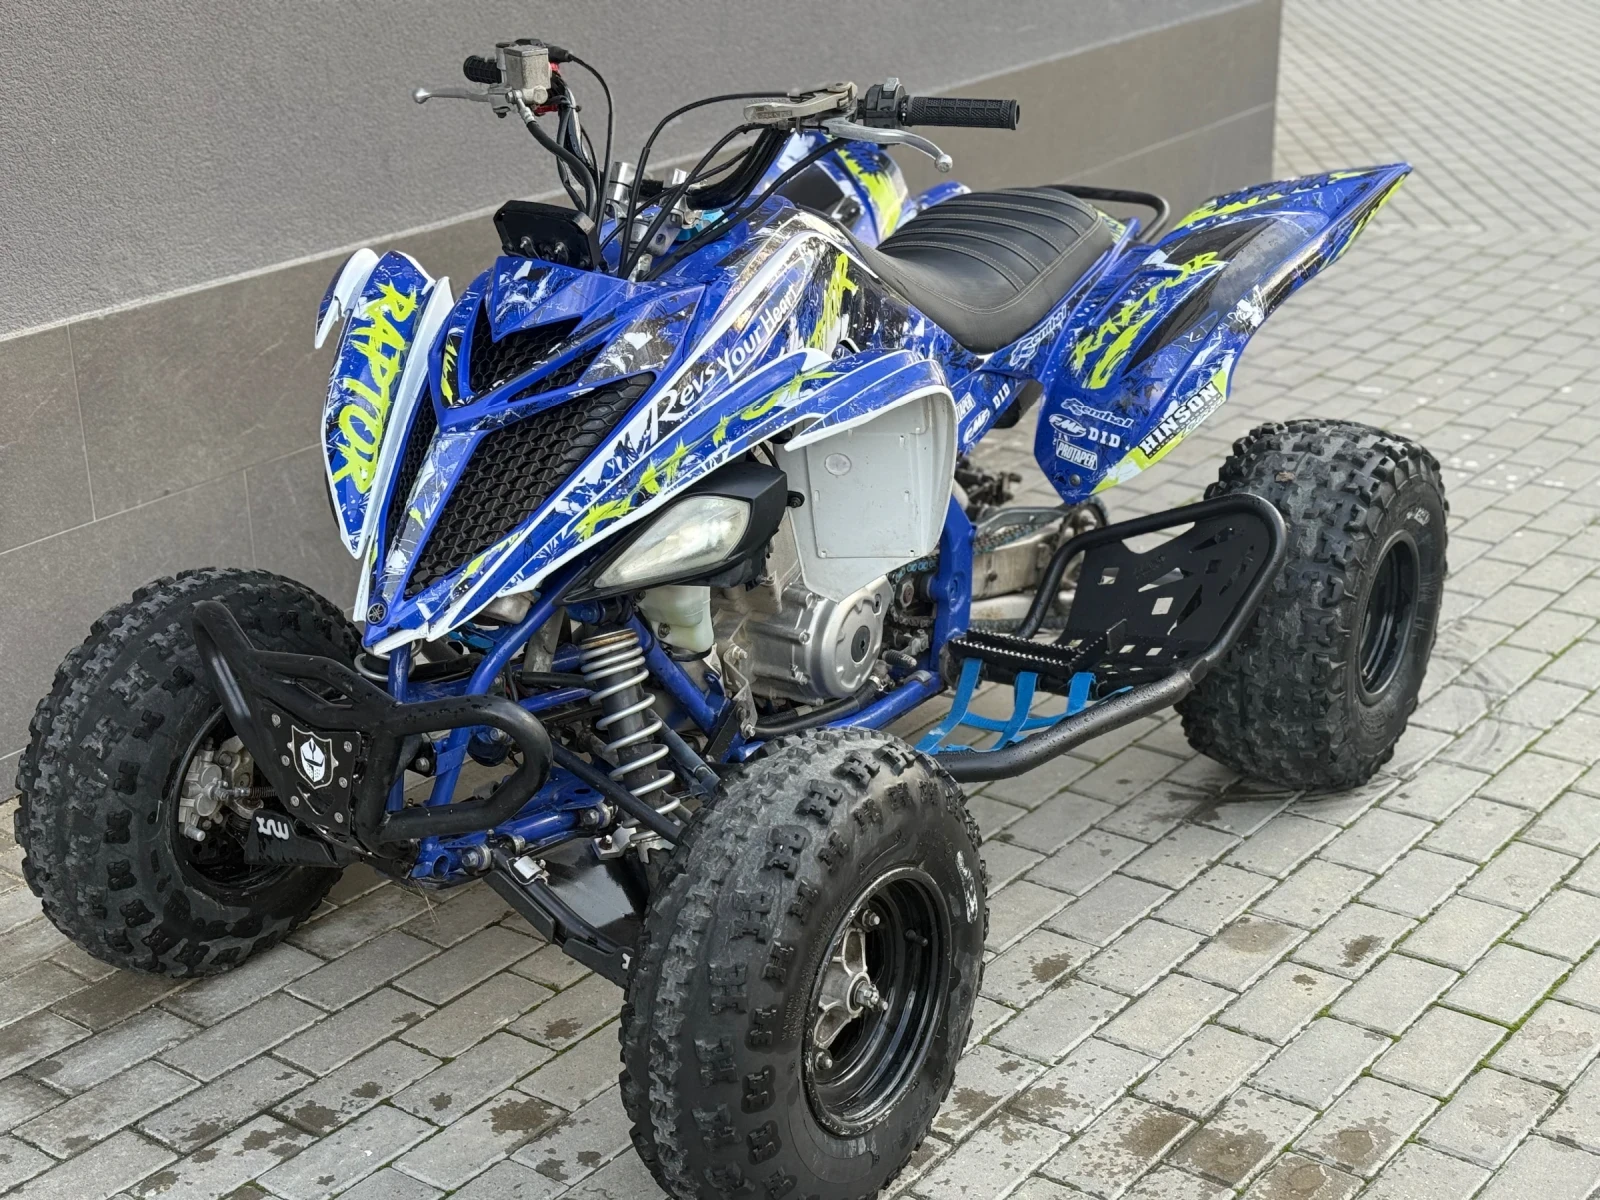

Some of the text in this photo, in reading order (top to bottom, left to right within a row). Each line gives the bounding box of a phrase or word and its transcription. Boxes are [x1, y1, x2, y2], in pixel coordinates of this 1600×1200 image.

[1010, 303, 1067, 367] Renthal
[1070, 250, 1222, 373] RAPTOR
[332, 282, 418, 494] RAPTOR
[648, 360, 718, 445] Revs
[715, 326, 764, 382] Your
[759, 280, 799, 343] Heart
[1049, 414, 1087, 436] FMF
[1061, 398, 1134, 428] Renthal
[1138, 381, 1219, 455] HINSON
[1058, 442, 1096, 468] PROTAPER
